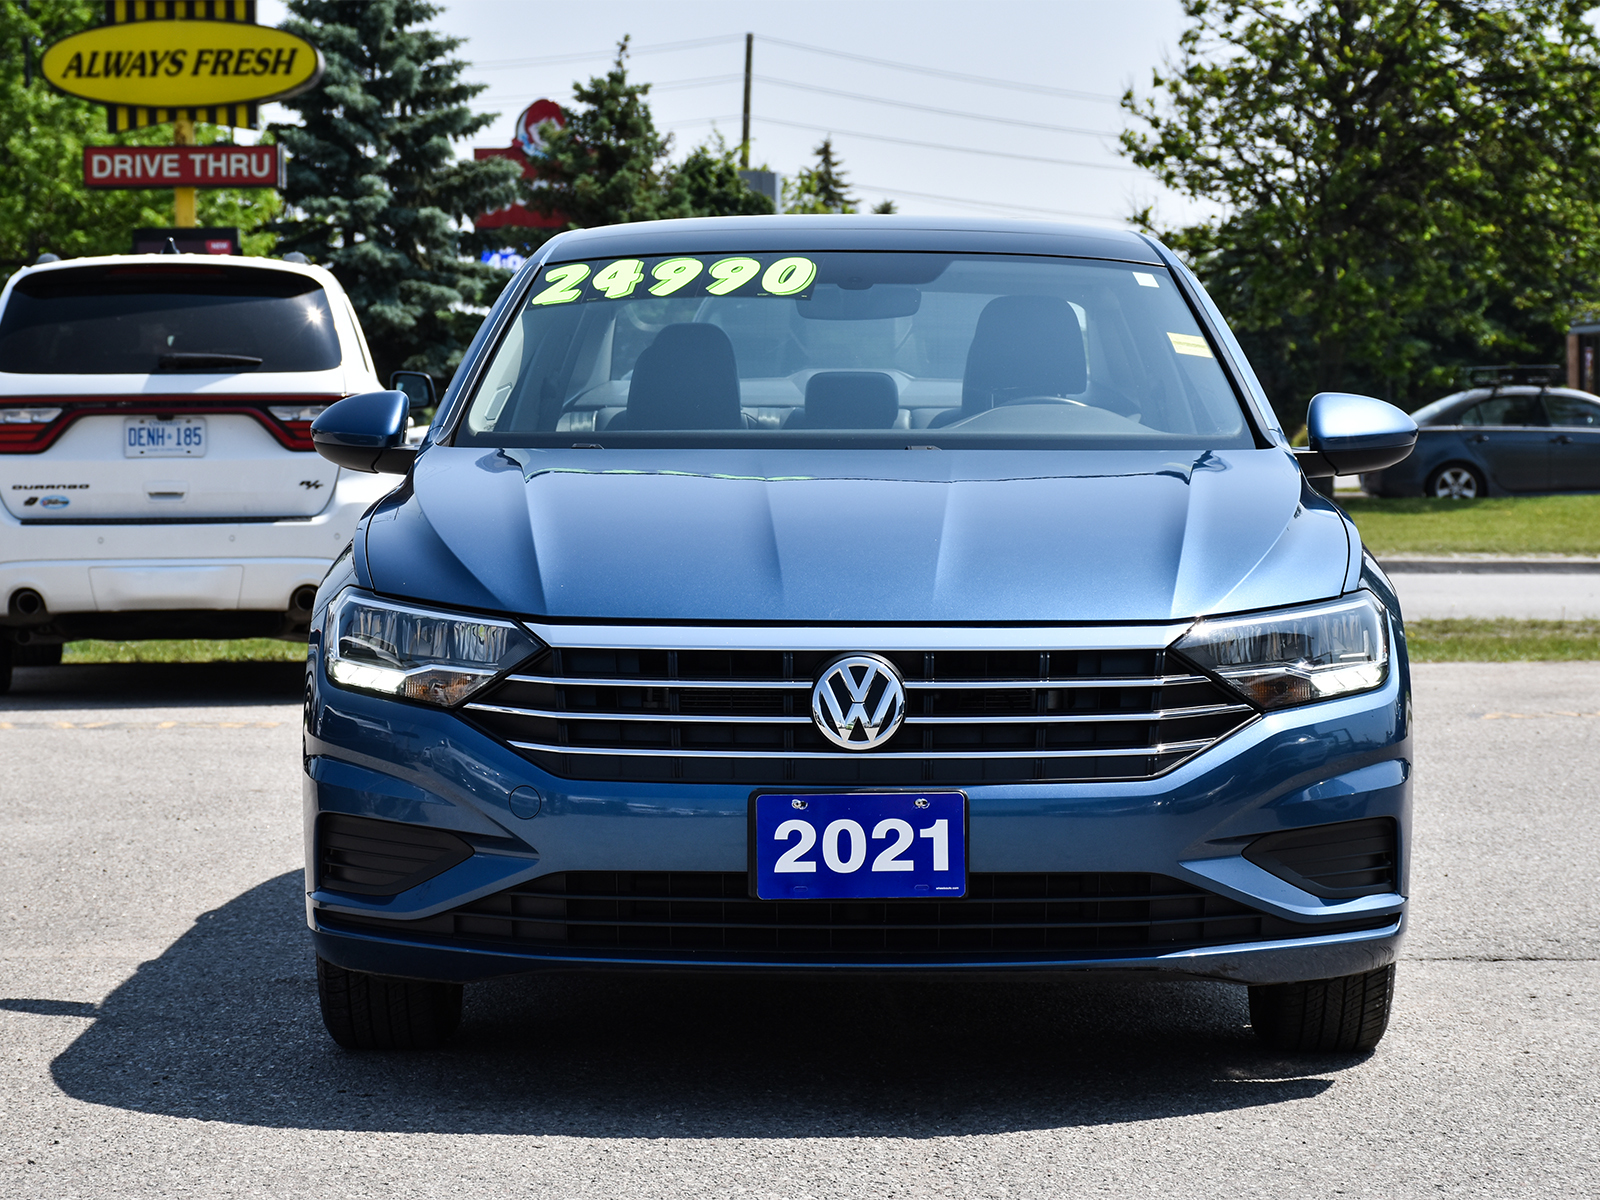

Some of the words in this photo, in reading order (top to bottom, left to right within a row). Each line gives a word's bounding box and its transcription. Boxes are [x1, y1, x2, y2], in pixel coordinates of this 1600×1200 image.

[62, 49, 187, 79] ALWAYS
[191, 47, 299, 77] FRESH
[91, 154, 180, 178] DRIVE
[189, 153, 271, 178] THRU
[532, 257, 817, 305] 24990
[128, 427, 165, 447] DENH
[175, 426, 202, 447] 185
[773, 818, 949, 874] 2021
